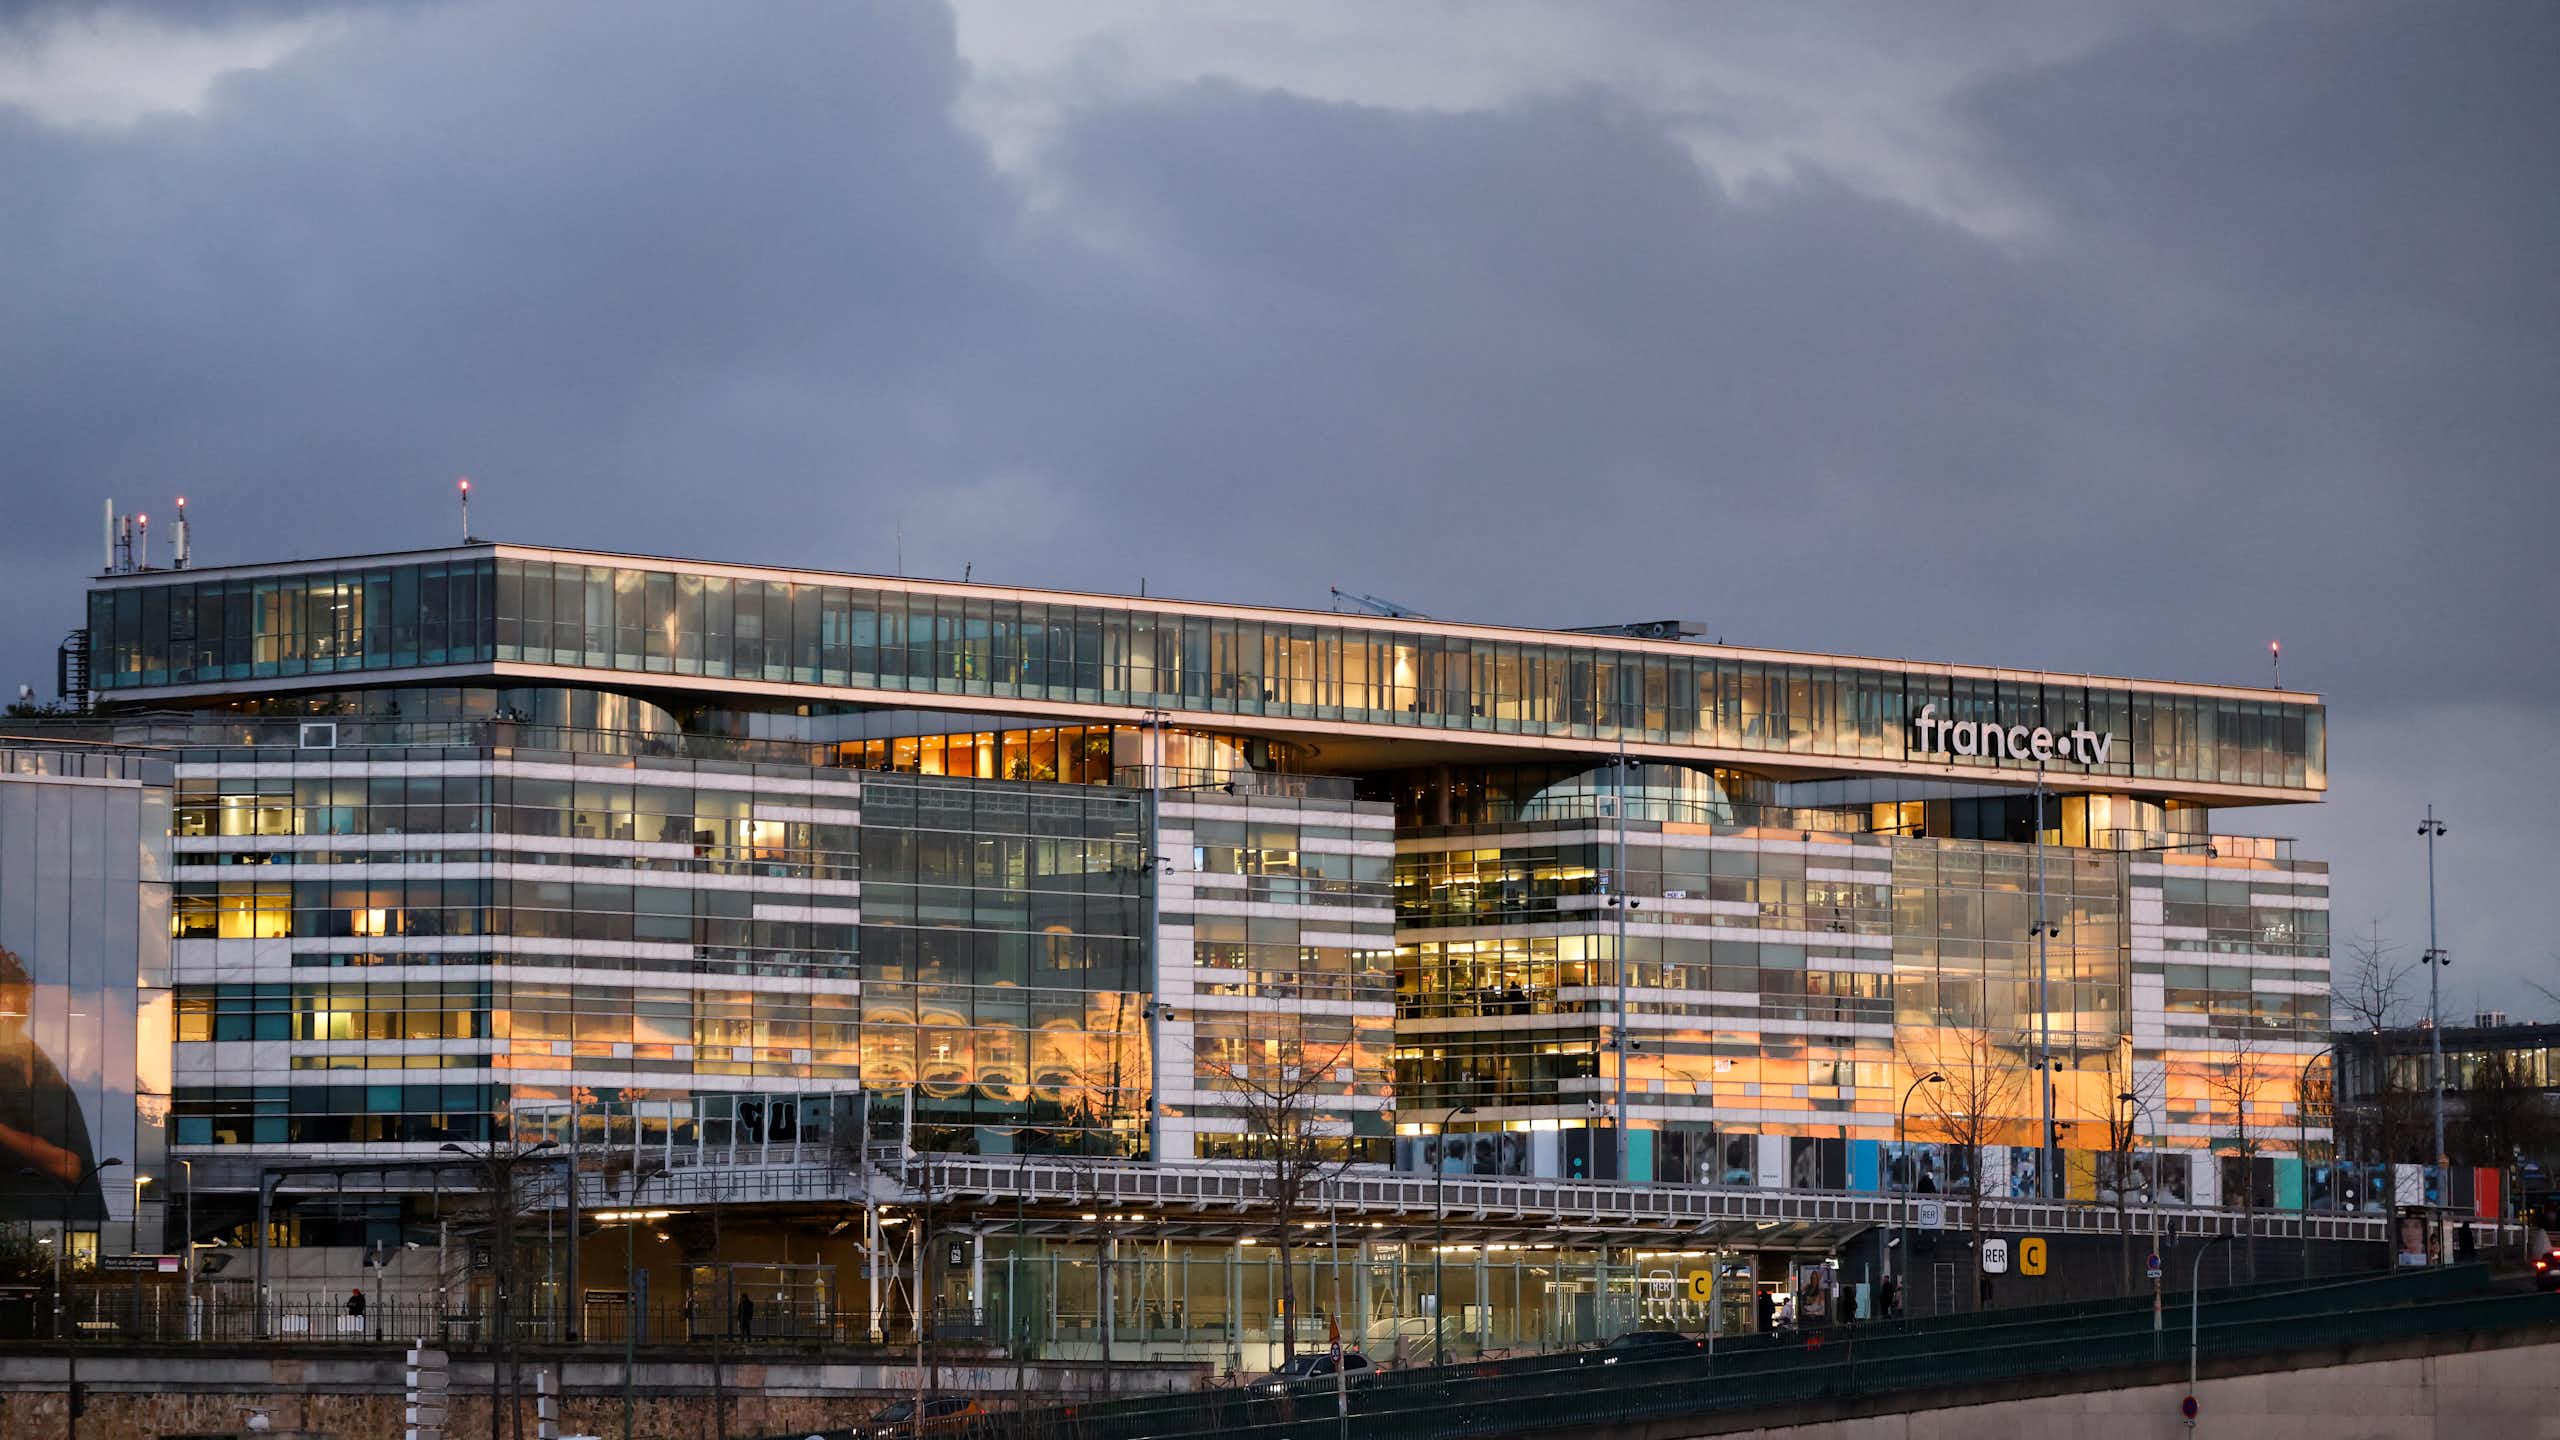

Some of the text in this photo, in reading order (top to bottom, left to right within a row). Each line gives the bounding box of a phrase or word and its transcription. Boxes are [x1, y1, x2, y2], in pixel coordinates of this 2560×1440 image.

[1922, 1210, 1936, 1219] RER
[1985, 1248, 2005, 1263] RER
[2027, 1246, 2038, 1268] C
[1652, 1279, 1670, 1291] RER
[1695, 1277, 1705, 1295] C
